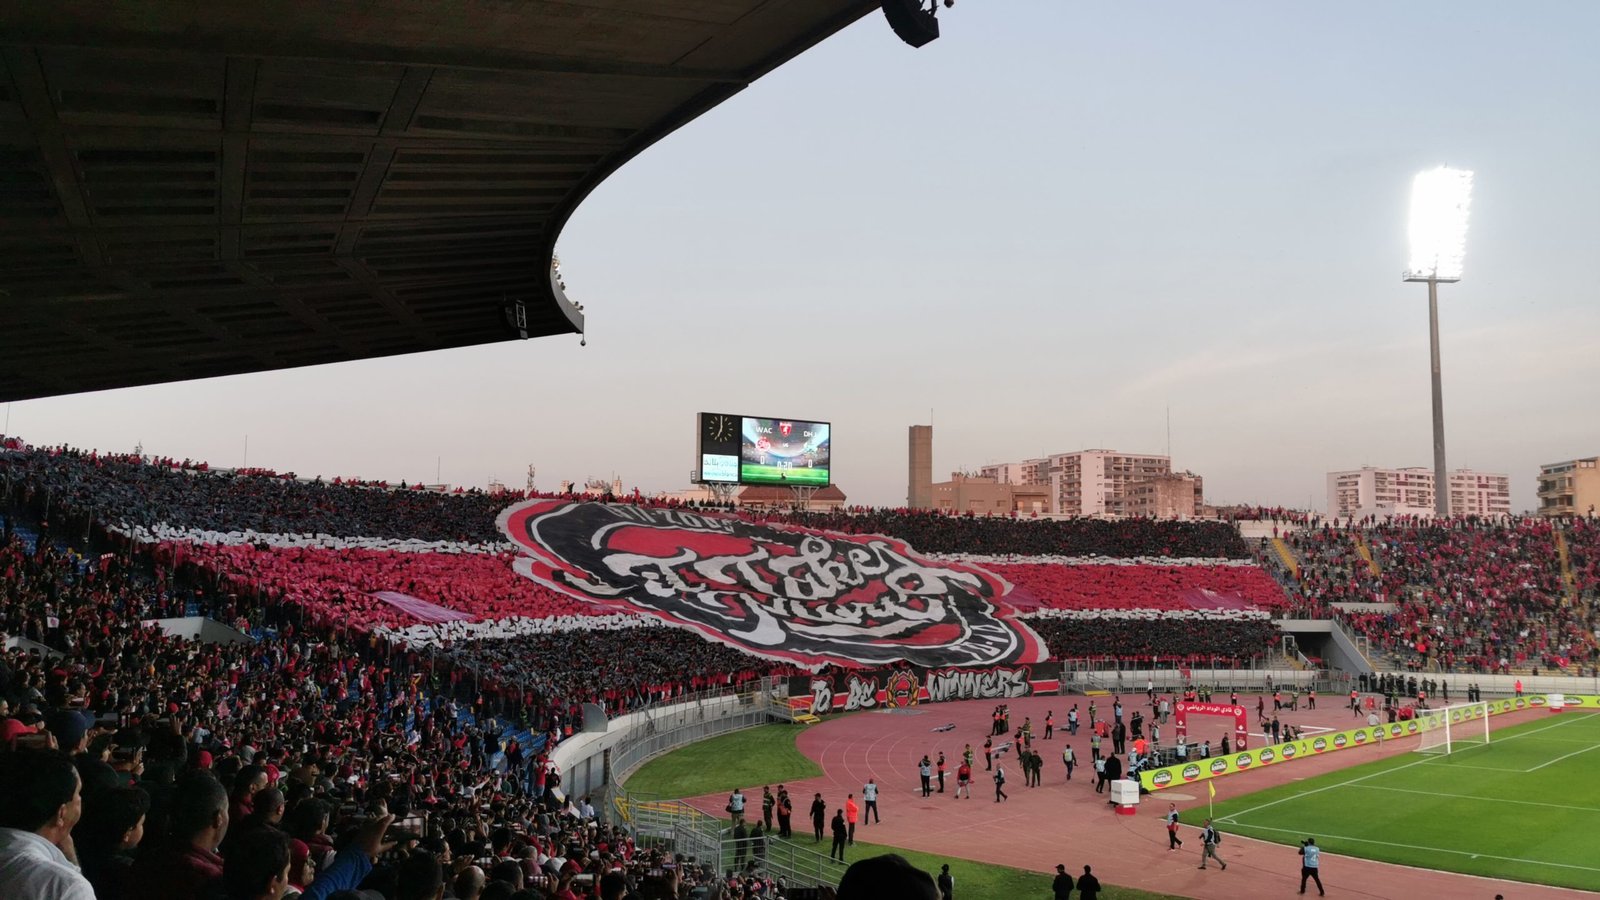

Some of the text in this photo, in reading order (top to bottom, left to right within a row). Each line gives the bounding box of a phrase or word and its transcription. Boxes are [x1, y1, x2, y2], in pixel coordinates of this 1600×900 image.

[755, 426, 773, 434] WAC
[810, 679, 830, 713] TO
[847, 677, 875, 711] BE
